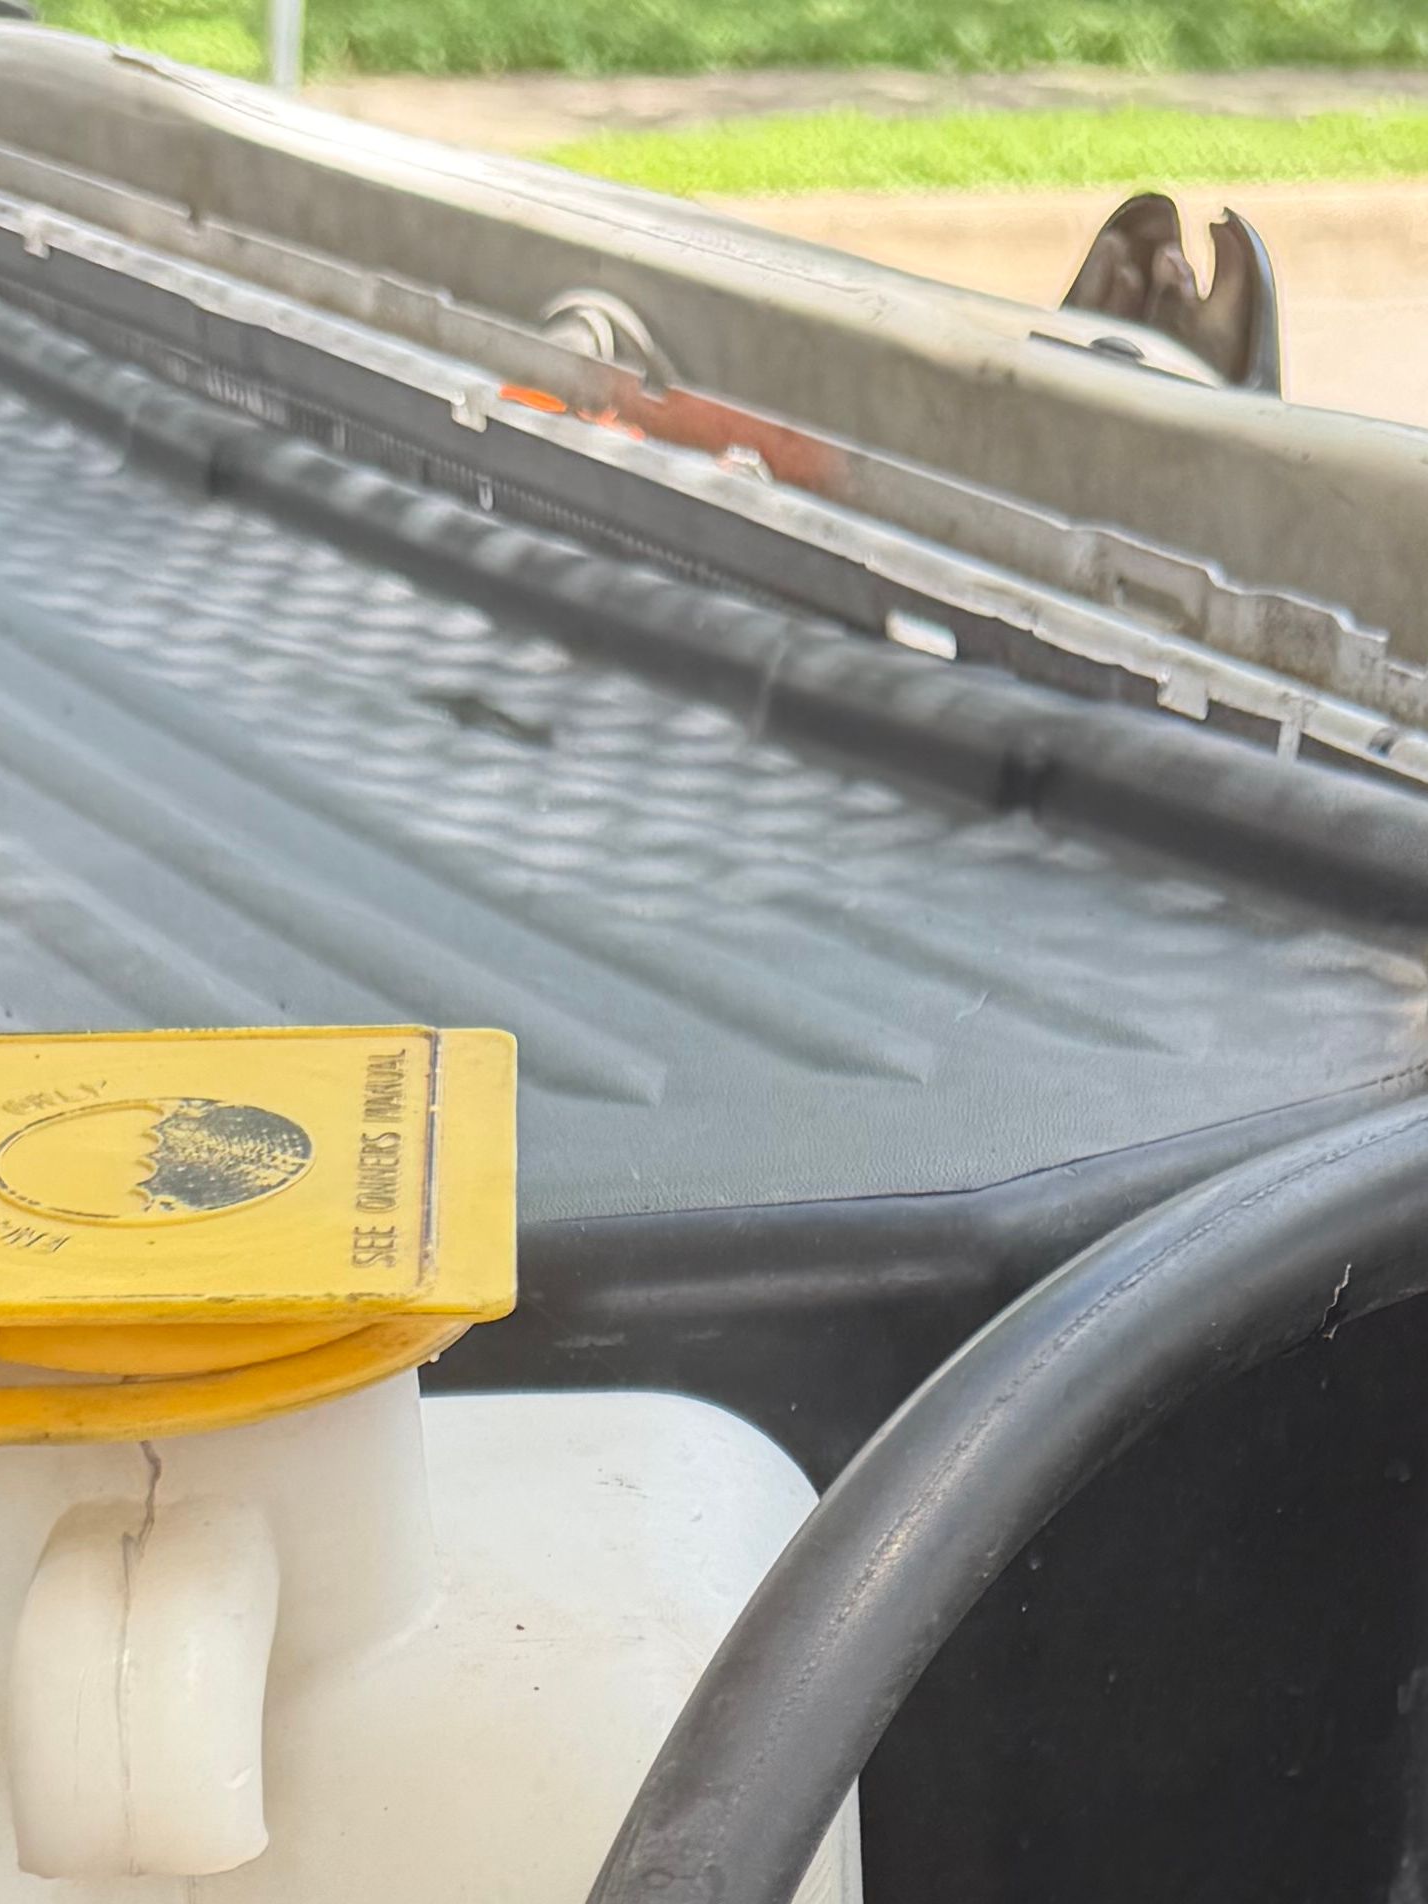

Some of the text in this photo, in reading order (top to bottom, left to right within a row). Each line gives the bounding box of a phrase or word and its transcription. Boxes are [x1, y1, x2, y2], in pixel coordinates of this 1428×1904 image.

[351, 1047, 407, 1268] SEE OWNERS MANUAL
